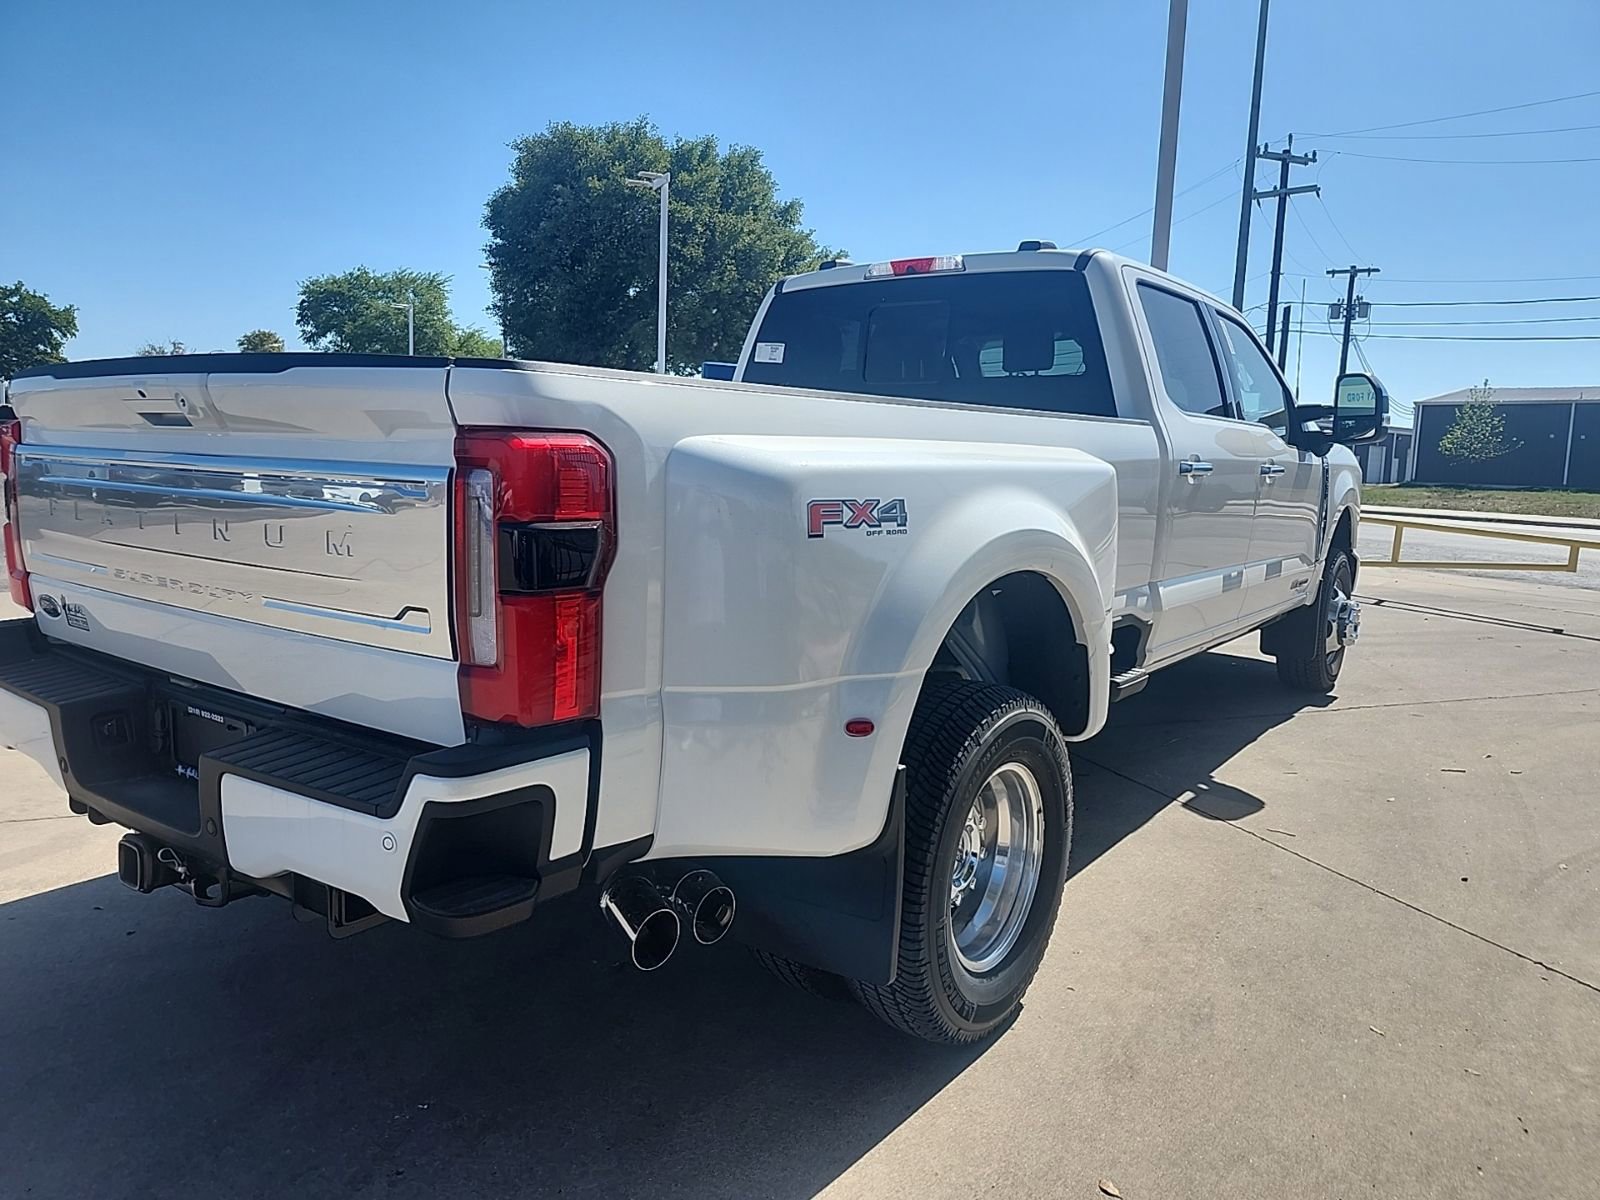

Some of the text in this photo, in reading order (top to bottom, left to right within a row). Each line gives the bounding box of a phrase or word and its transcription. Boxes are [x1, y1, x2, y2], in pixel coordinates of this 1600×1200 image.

[49, 499, 354, 557] PLATINUM
[807, 499, 907, 538] FX4
[113, 567, 253, 604] SUPER DUTY
